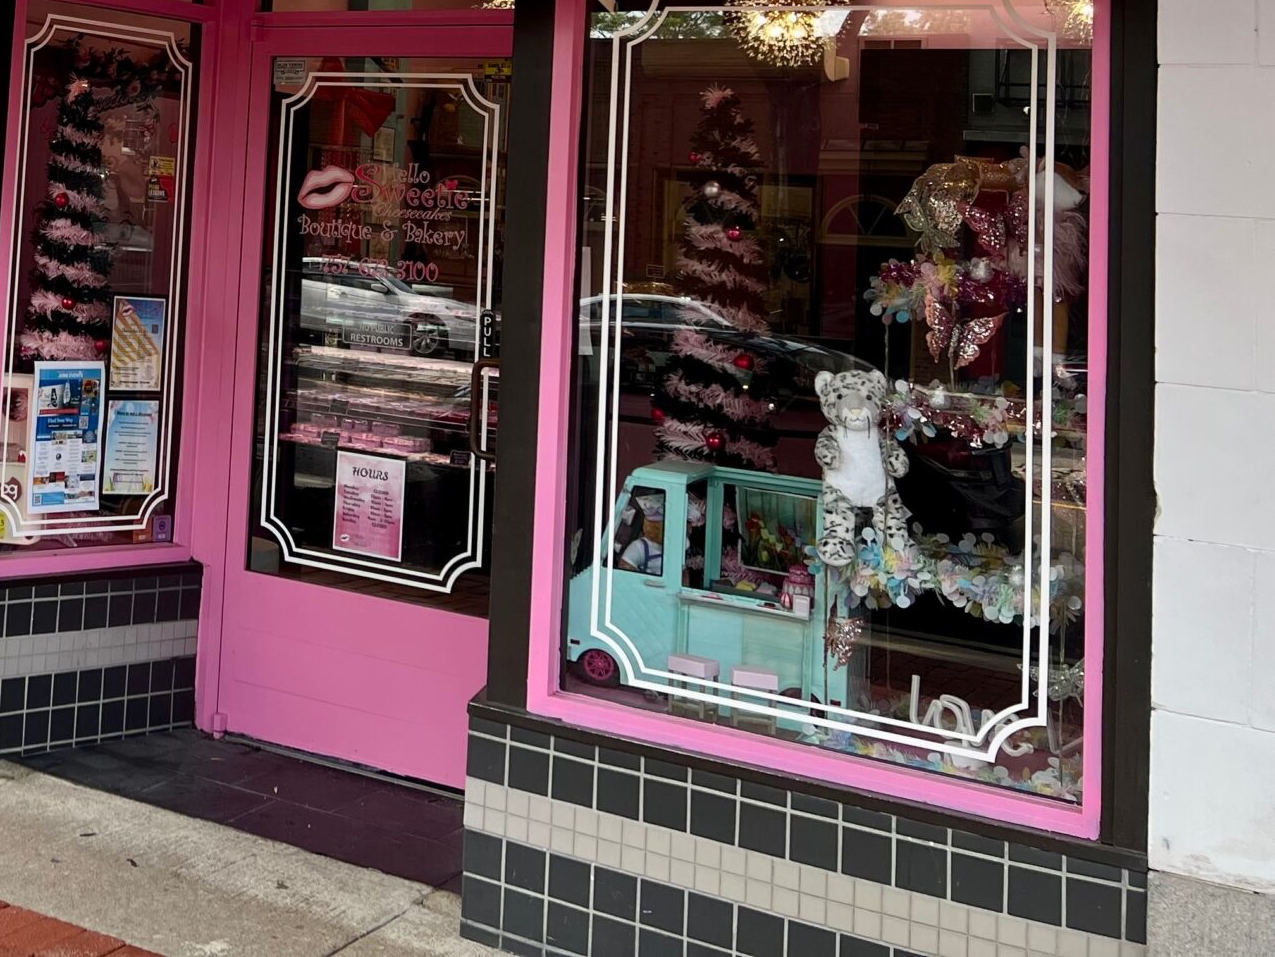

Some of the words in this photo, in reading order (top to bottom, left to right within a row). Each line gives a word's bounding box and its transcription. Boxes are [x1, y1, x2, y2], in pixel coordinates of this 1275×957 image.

[351, 162, 469, 210] Sweetie
[373, 202, 453, 222] Cheesecakes
[297, 213, 373, 244] Boutique
[380, 220, 398, 242] &
[402, 219, 467, 251] Bakery
[396, 259, 439, 283] 3100
[350, 333, 404, 347] RESTROOMS
[483, 316, 492, 357] PULL
[352, 466, 389, 481] HOURS
